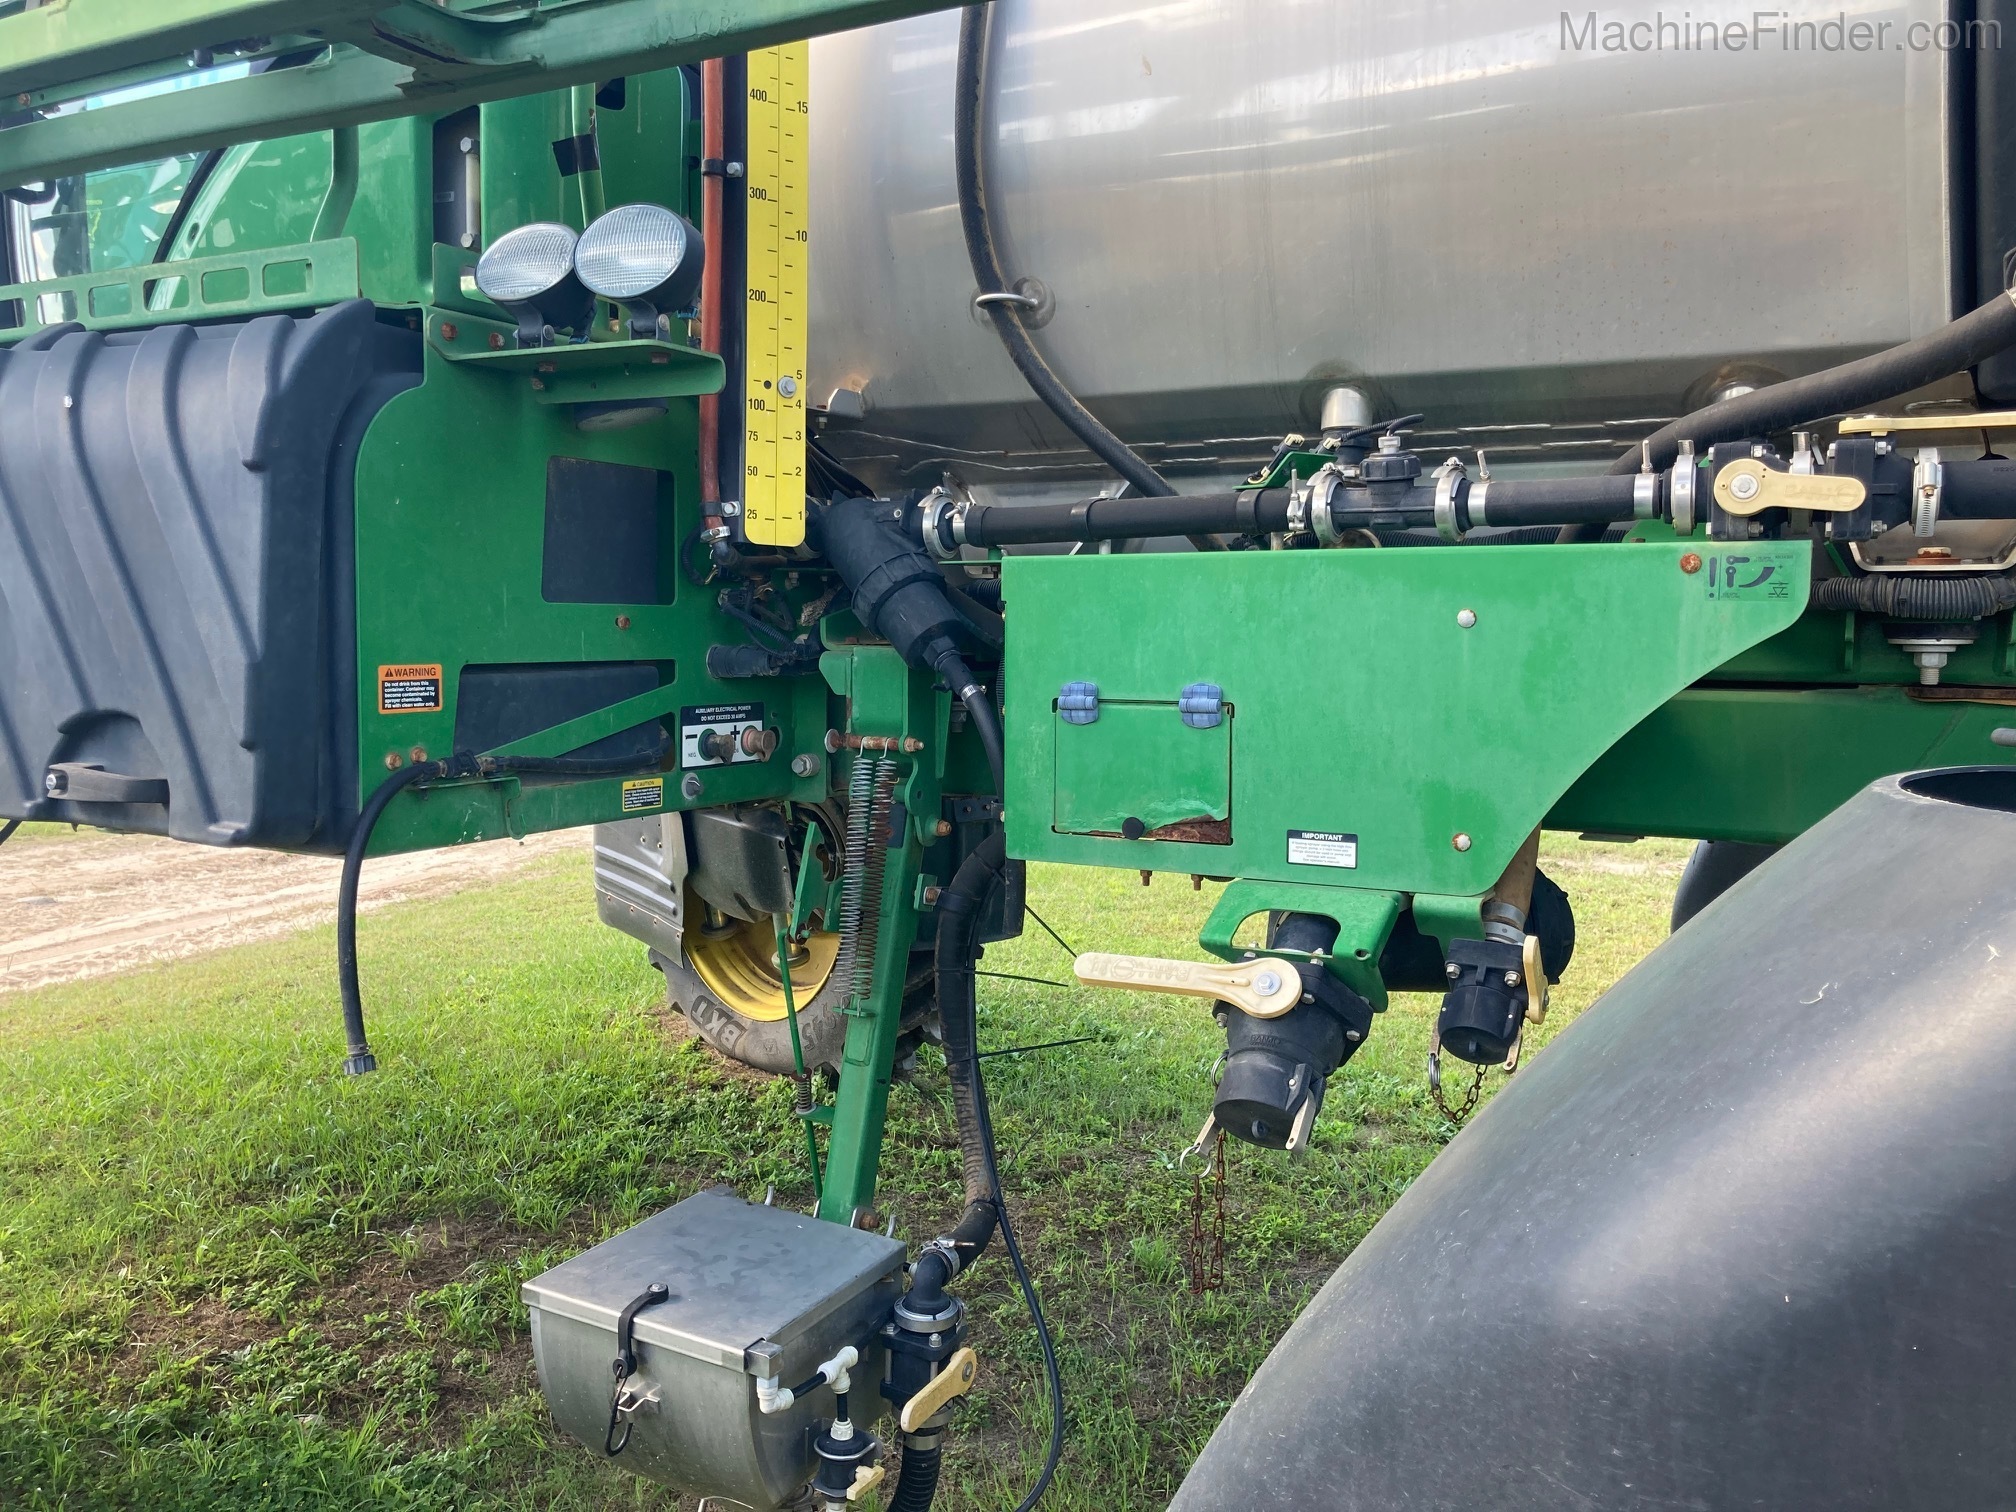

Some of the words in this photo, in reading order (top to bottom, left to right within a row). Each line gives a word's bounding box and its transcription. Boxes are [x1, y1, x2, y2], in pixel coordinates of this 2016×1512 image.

[749, 88, 767, 102] 400
[796, 101, 808, 114] 15
[749, 186, 767, 201] 300
[796, 230, 808, 243] 10
[748, 289, 766, 302] 200
[796, 370, 802, 380] 5
[748, 399, 765, 411] 100
[795, 399, 802, 409] 4
[748, 431, 758, 441] 75
[795, 431, 802, 441] 3
[747, 466, 758, 477] 50
[795, 467, 802, 476] 2
[747, 509, 757, 520] 25
[798, 511, 802, 520] 1
[394, 668, 436, 677] WARNING
[1302, 832, 1343, 842] IMPORTANT
[691, 999, 742, 1050] BKT
